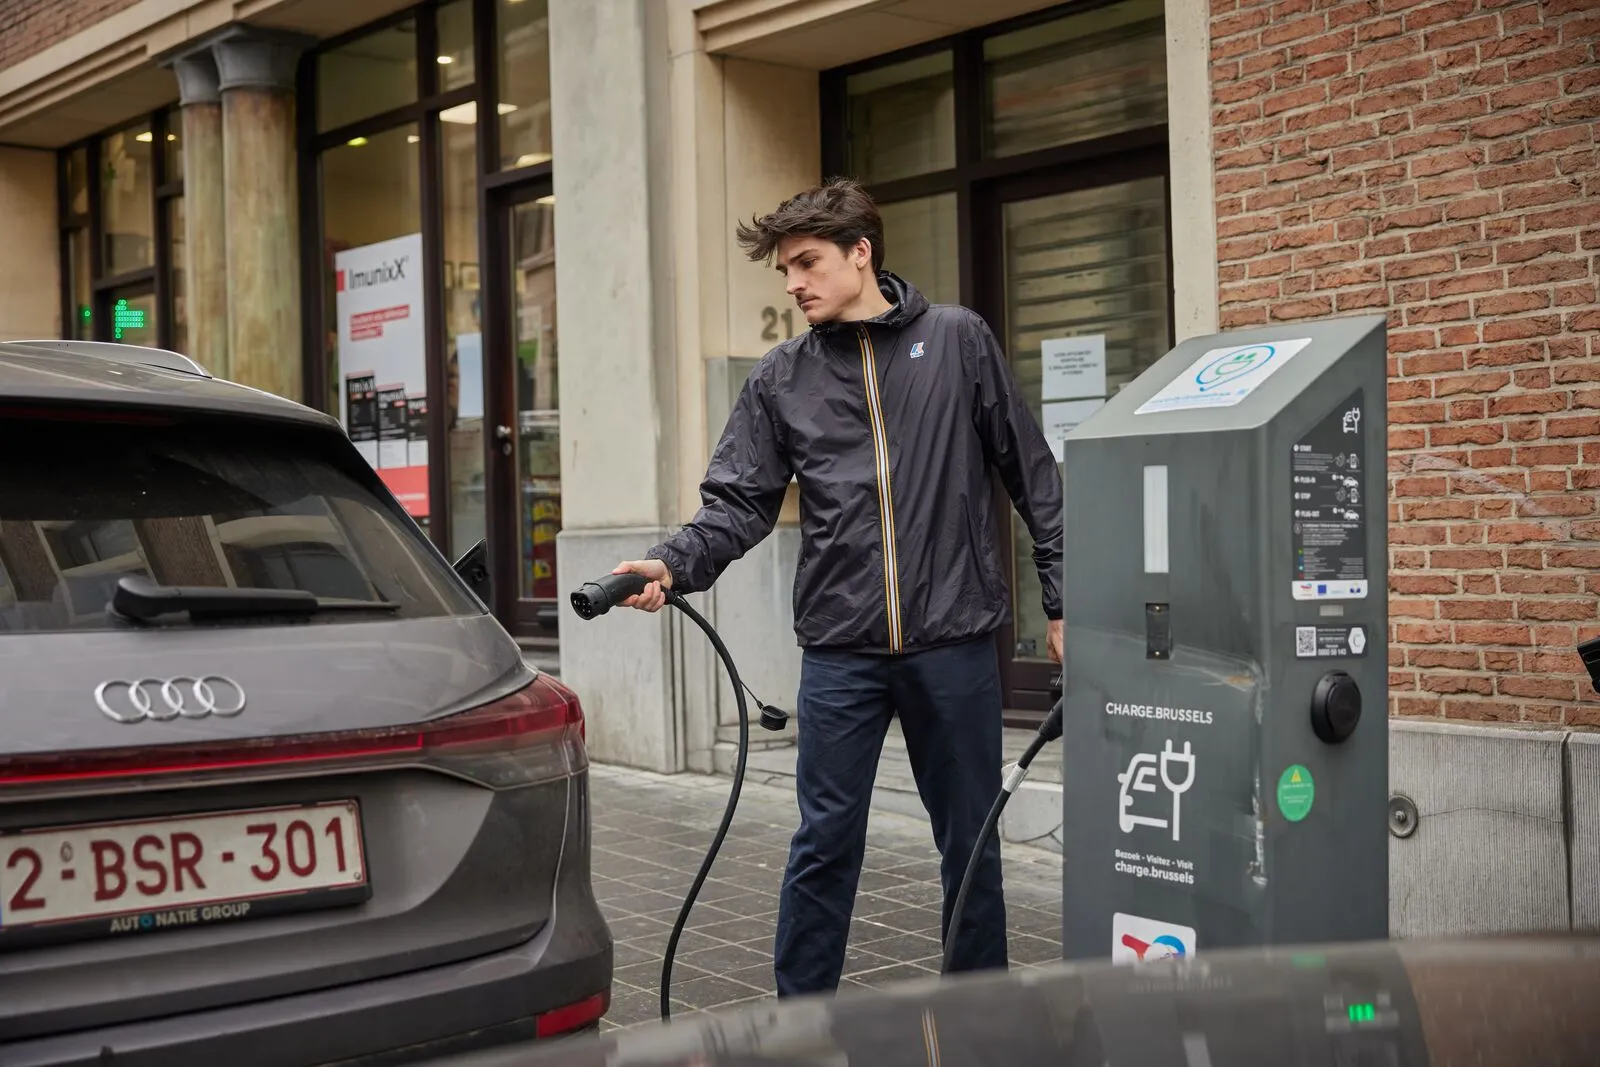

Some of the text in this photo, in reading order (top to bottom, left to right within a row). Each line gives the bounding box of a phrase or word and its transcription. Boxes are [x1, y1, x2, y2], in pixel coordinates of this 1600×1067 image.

[761, 305, 793, 340] 21
[1105, 702, 1213, 724] CHARGE.BRUSSELS
[1115, 849, 1140, 861] Bezoek
[1146, 854, 1171, 867] Visitez
[1176, 859, 1193, 871] Visit
[1115, 860, 1194, 885] charge.brussels
[110, 902, 250, 932] AUTO NATIE GROUP
